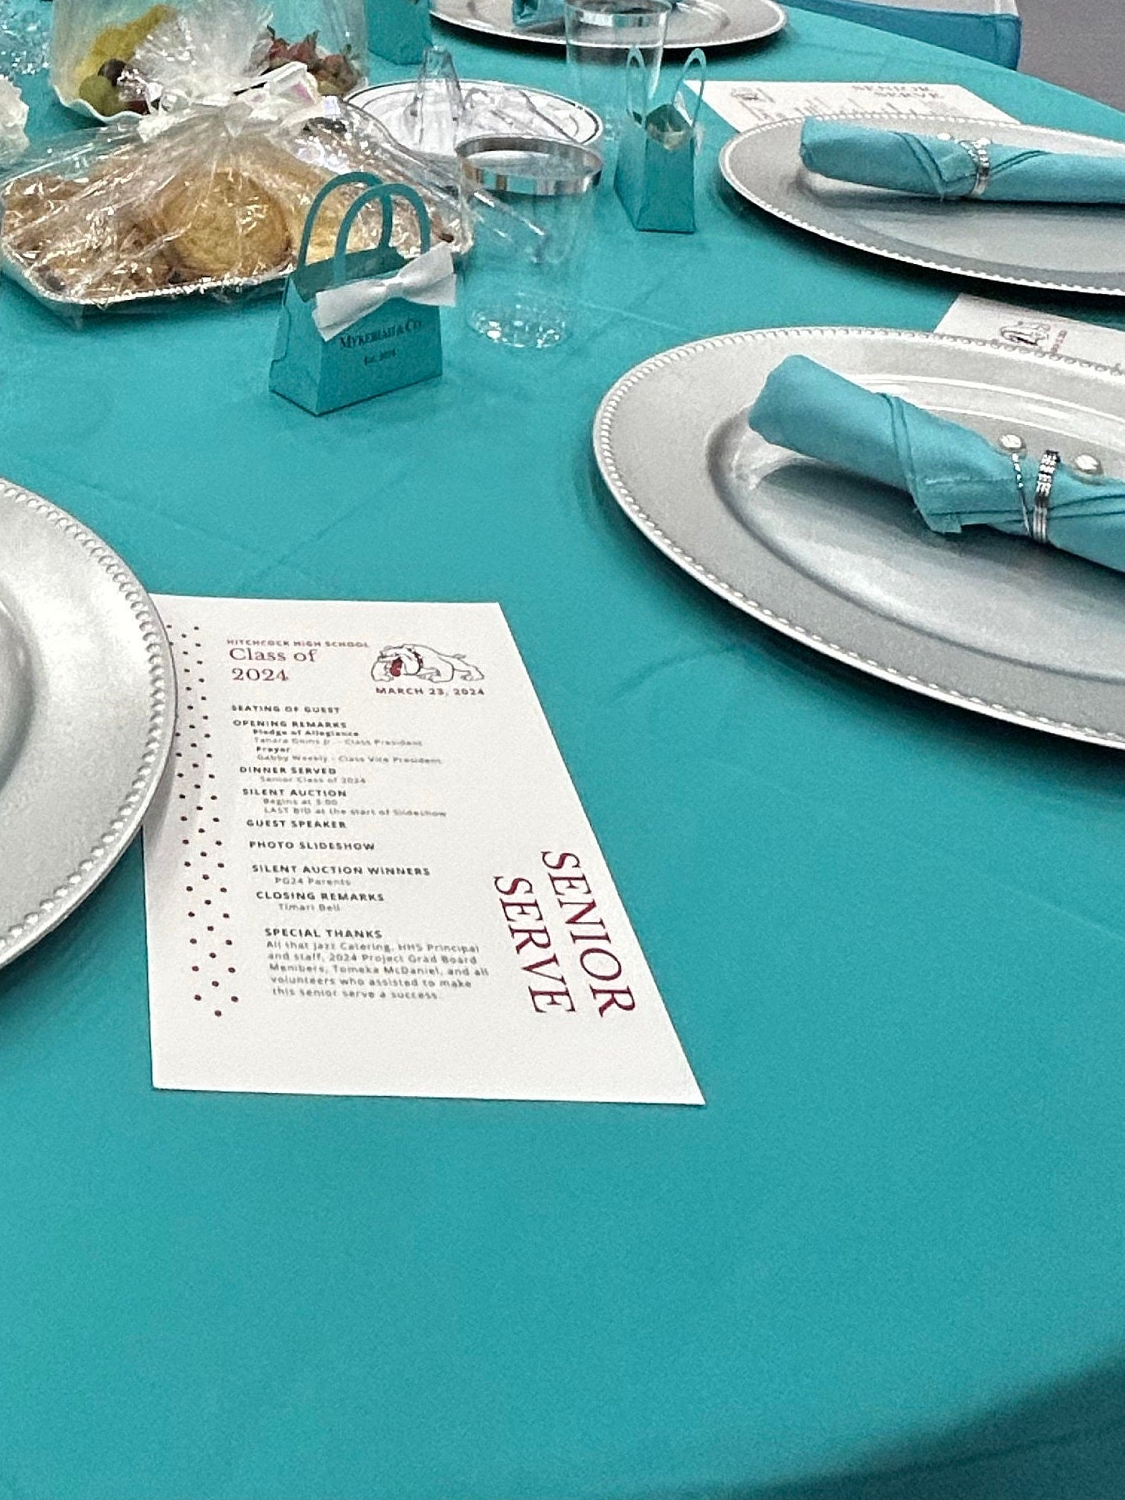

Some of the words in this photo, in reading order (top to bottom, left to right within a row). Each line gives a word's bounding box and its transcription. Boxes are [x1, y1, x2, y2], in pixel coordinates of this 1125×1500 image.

[226, 639, 290, 647] HITCHCOCK
[229, 647, 287, 661] Class
[293, 649, 317, 662] of
[231, 667, 289, 681] 2024
[375, 687, 424, 695] MARCH
[454, 688, 485, 696] 2024
[231, 705, 280, 713] SEATING
[233, 719, 287, 728] OPENING
[292, 721, 347, 729] REMARKS
[253, 728, 287, 737] Pledge
[305, 730, 359, 738] Allegiance
[256, 746, 291, 754] Prayer
[239, 766, 287, 774] DINNER
[291, 767, 337, 775] SERVED
[242, 788, 285, 796] SILENT
[290, 789, 347, 797] AUCTION
[246, 819, 286, 828] GUEST
[291, 820, 347, 829] SPEAKER
[249, 840, 294, 849] PHOTO
[299, 841, 375, 851] SLIDESHOW
[252, 864, 297, 873] SILENT
[303, 865, 363, 875] AUCTION
[367, 866, 430, 876] WINNERS
[275, 876, 303, 885] PG24
[308, 877, 351, 886] Parents
[256, 891, 315, 900] CLOSING
[321, 892, 384, 901] REMARKS
[318, 903, 341, 911] Bell
[265, 928, 321, 938] SPECIAL
[325, 929, 383, 939] THANKS
[540, 850, 636, 1018] SENIOR
[266, 940, 281, 949] All
[285, 941, 308, 950] that
[398, 943, 423, 952] HHS
[427, 943, 480, 954] Principal
[493, 875, 577, 1014] SERVE
[329, 953, 357, 962] 2024
[362, 954, 404, 965] Project
[408, 954, 437, 963] Grad
[441, 955, 477, 965] Board
[333, 965, 379, 973] Tomeka
[447, 968, 470, 976] and
[475, 967, 489, 976] all
[271, 975, 335, 985] volunteers
[340, 977, 365, 986] who
[369, 979, 418, 987] assisted
[440, 979, 472, 988] make
[273, 986, 296, 996] this
[299, 988, 337, 997] senior
[342, 990, 375, 998] serve
